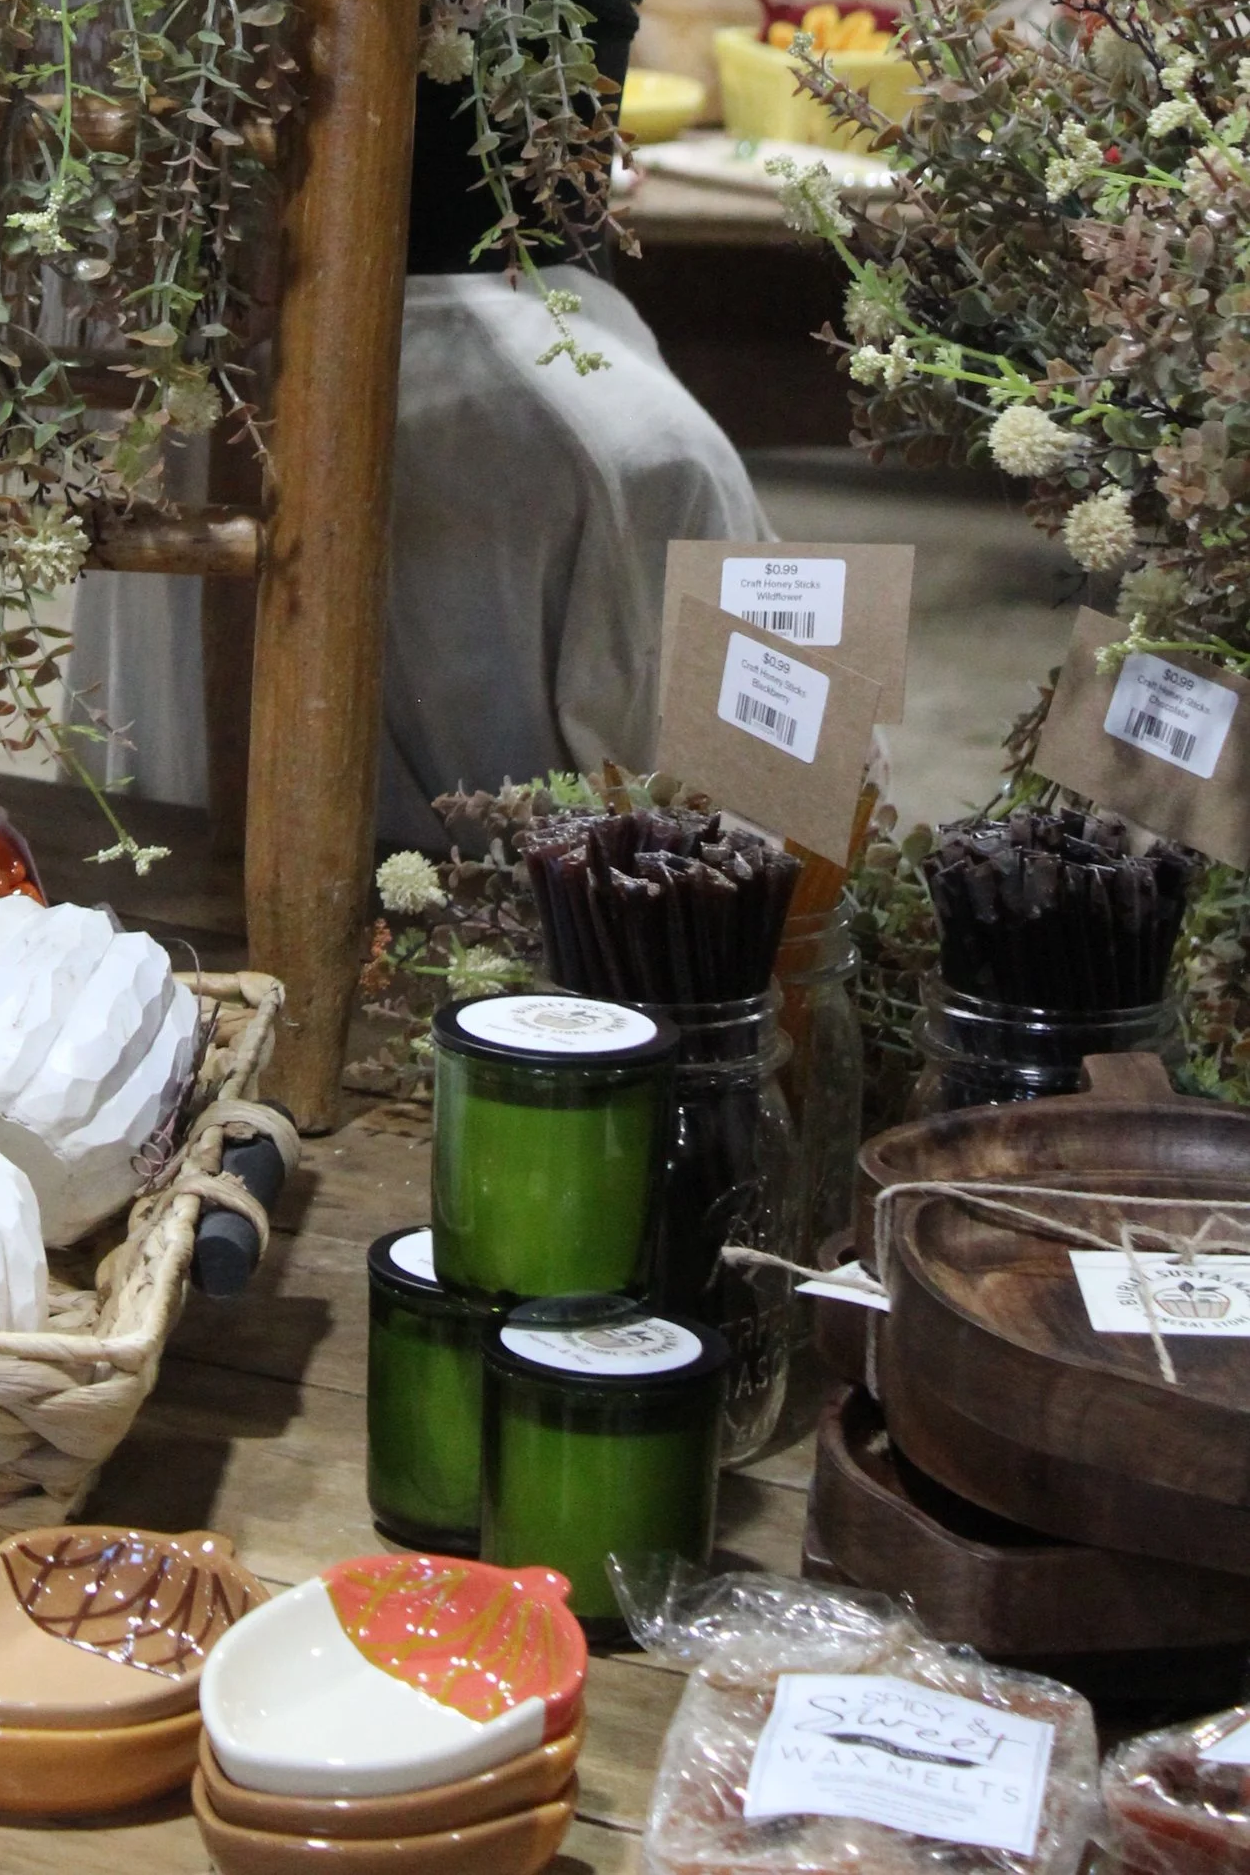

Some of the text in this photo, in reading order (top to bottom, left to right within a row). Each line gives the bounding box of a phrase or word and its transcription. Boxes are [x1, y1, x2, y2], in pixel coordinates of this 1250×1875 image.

[764, 563, 798, 576] $0.99
[740, 579, 821, 590] Craft Honey Sticks
[756, 592, 803, 602] Wildflower
[762, 652, 791, 674] $0.99
[740, 659, 808, 699] Craft Honey Sticks
[751, 677, 791, 705] Blackberry
[1162, 668, 1196, 691] $0.99
[1137, 674, 1212, 715] Craft Honey Sticks
[1148, 694, 1190, 720] Chocolate
[861, 1689, 956, 1722] SPICY
[793, 1694, 1030, 1761] Sweet
[780, 1744, 871, 1769] WAX
[887, 1760, 1022, 1805] MELTS
